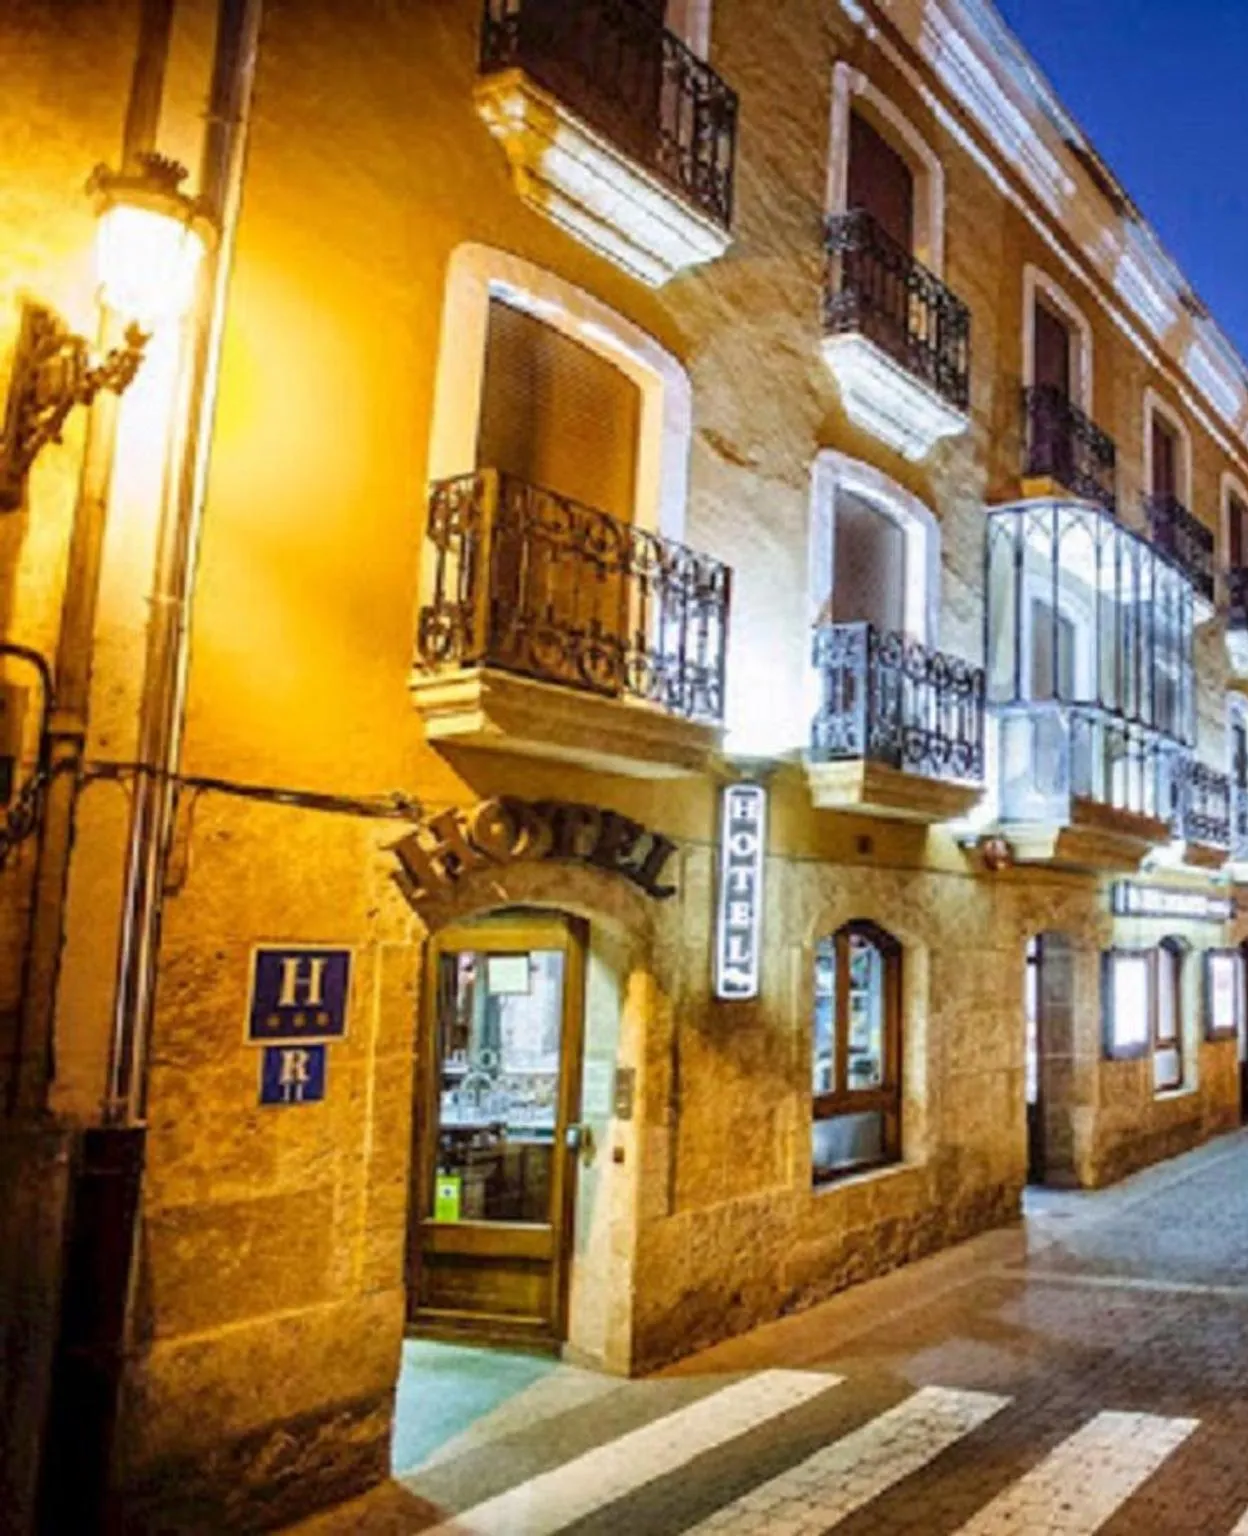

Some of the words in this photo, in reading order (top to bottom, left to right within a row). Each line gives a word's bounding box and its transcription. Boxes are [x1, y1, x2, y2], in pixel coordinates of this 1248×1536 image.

[379, 795, 678, 898] HOSTEL
[728, 798, 758, 965] HOTEL
[278, 957, 327, 1007] H
[279, 1049, 311, 1085] R
